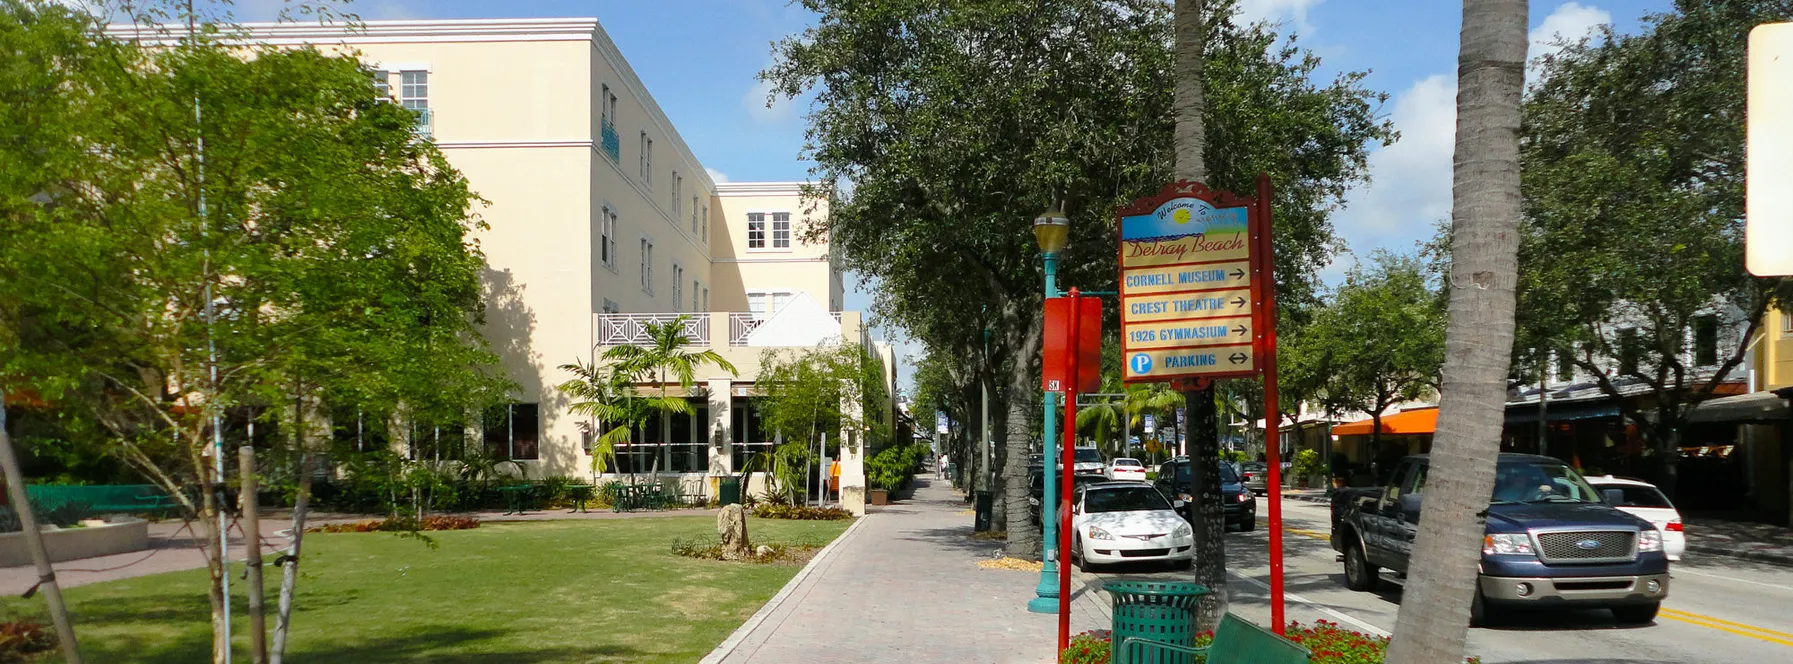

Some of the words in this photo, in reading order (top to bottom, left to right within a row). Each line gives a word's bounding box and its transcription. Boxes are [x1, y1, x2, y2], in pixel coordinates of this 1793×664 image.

[1157, 202, 1194, 220] Welcome
[1198, 204, 1210, 216] To
[1126, 240, 1188, 260] Delray
[1191, 231, 1244, 253] Beach
[1126, 274, 1174, 287] CORNELL
[1178, 270, 1225, 283] MUSEUM
[1131, 301, 1168, 315] CREST
[1172, 298, 1224, 312] THEATRE
[1130, 330, 1155, 342] 1926
[1159, 326, 1227, 341] GYMNASIUM
[1136, 355, 1148, 372] P
[1165, 354, 1216, 368] PARKING
